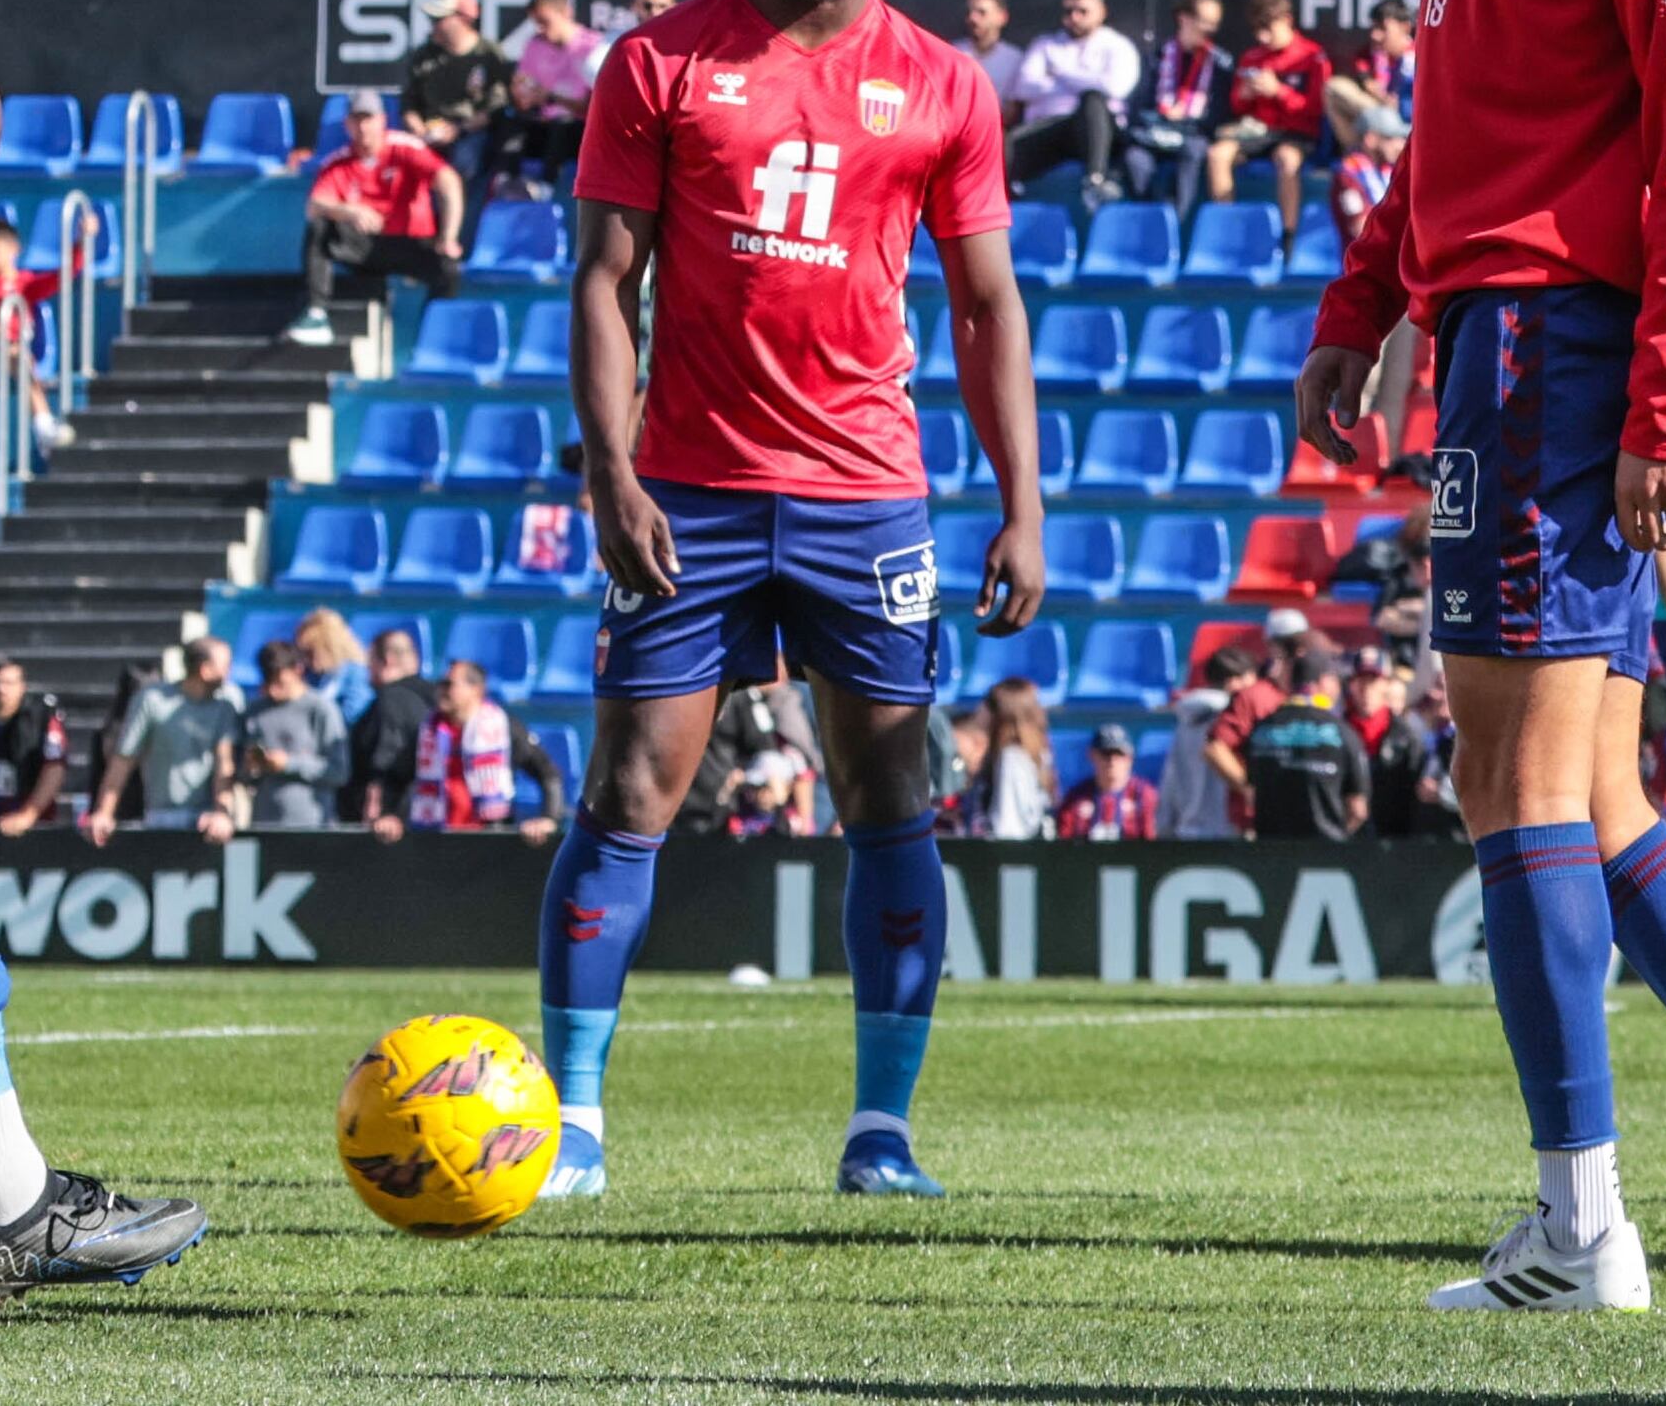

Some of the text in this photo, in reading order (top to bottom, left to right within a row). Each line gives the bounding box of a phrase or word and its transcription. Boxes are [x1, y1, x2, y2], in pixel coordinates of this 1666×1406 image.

[752, 139, 841, 241] fi
[731, 229, 850, 270] network
[1430, 478, 1465, 516] RC
